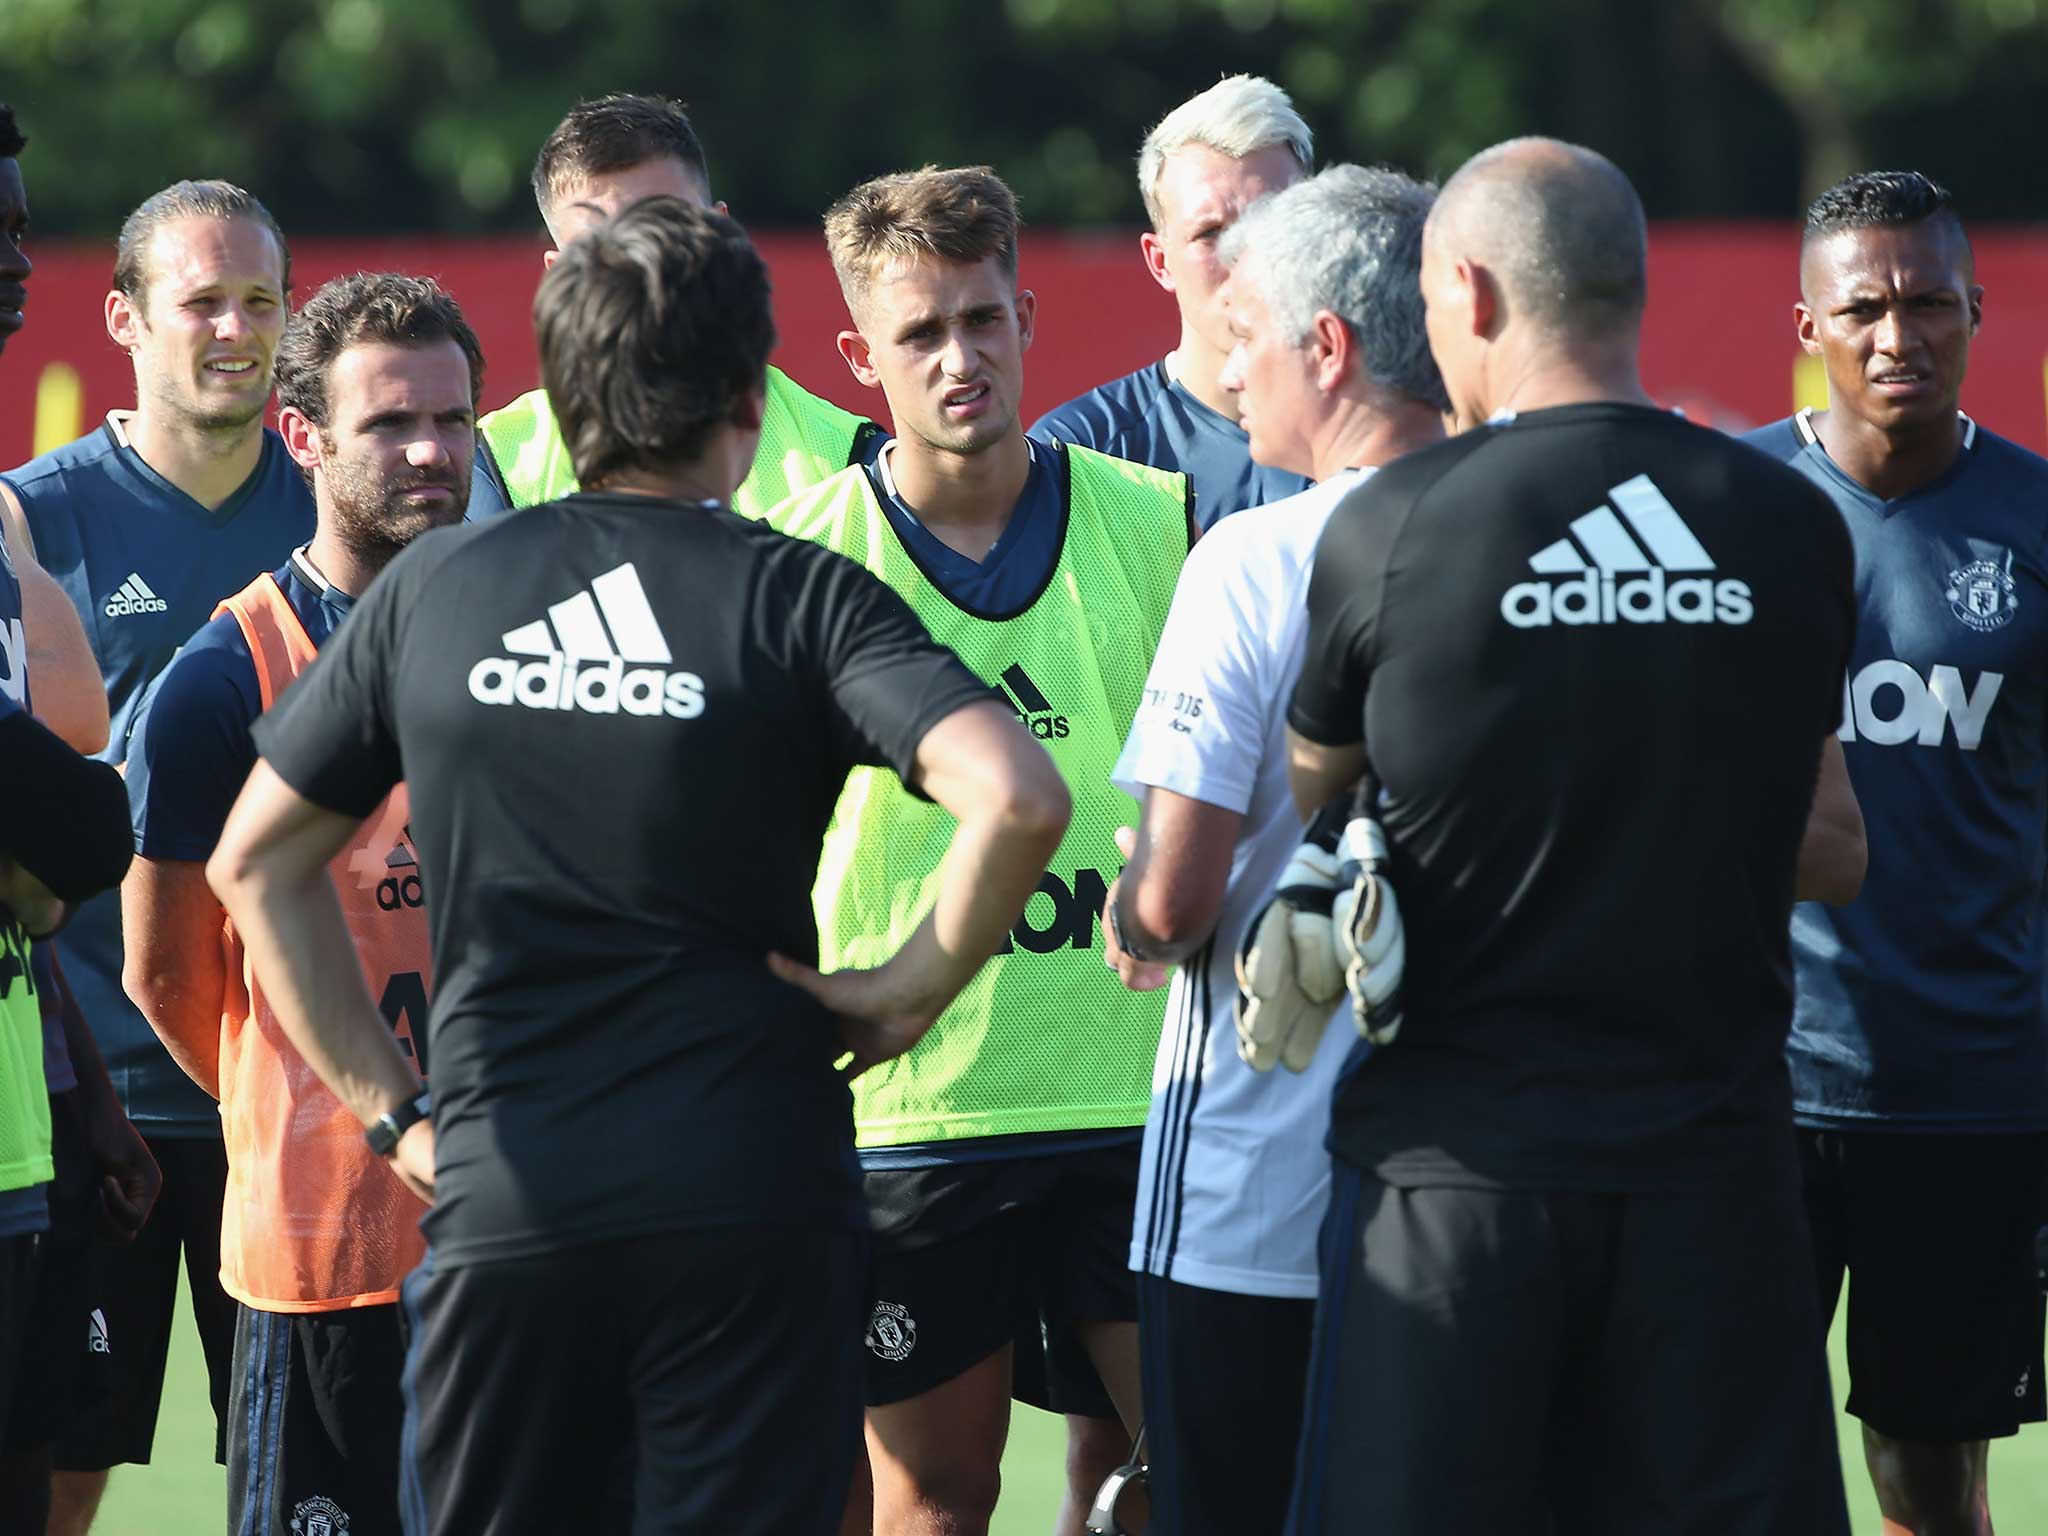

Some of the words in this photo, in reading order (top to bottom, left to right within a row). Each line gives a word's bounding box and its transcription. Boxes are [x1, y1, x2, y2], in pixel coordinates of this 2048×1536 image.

[104, 598, 168, 617] adidas
[1500, 566, 1755, 629] adidas
[467, 650, 706, 719] adidas
[993, 866, 1123, 954] ON
